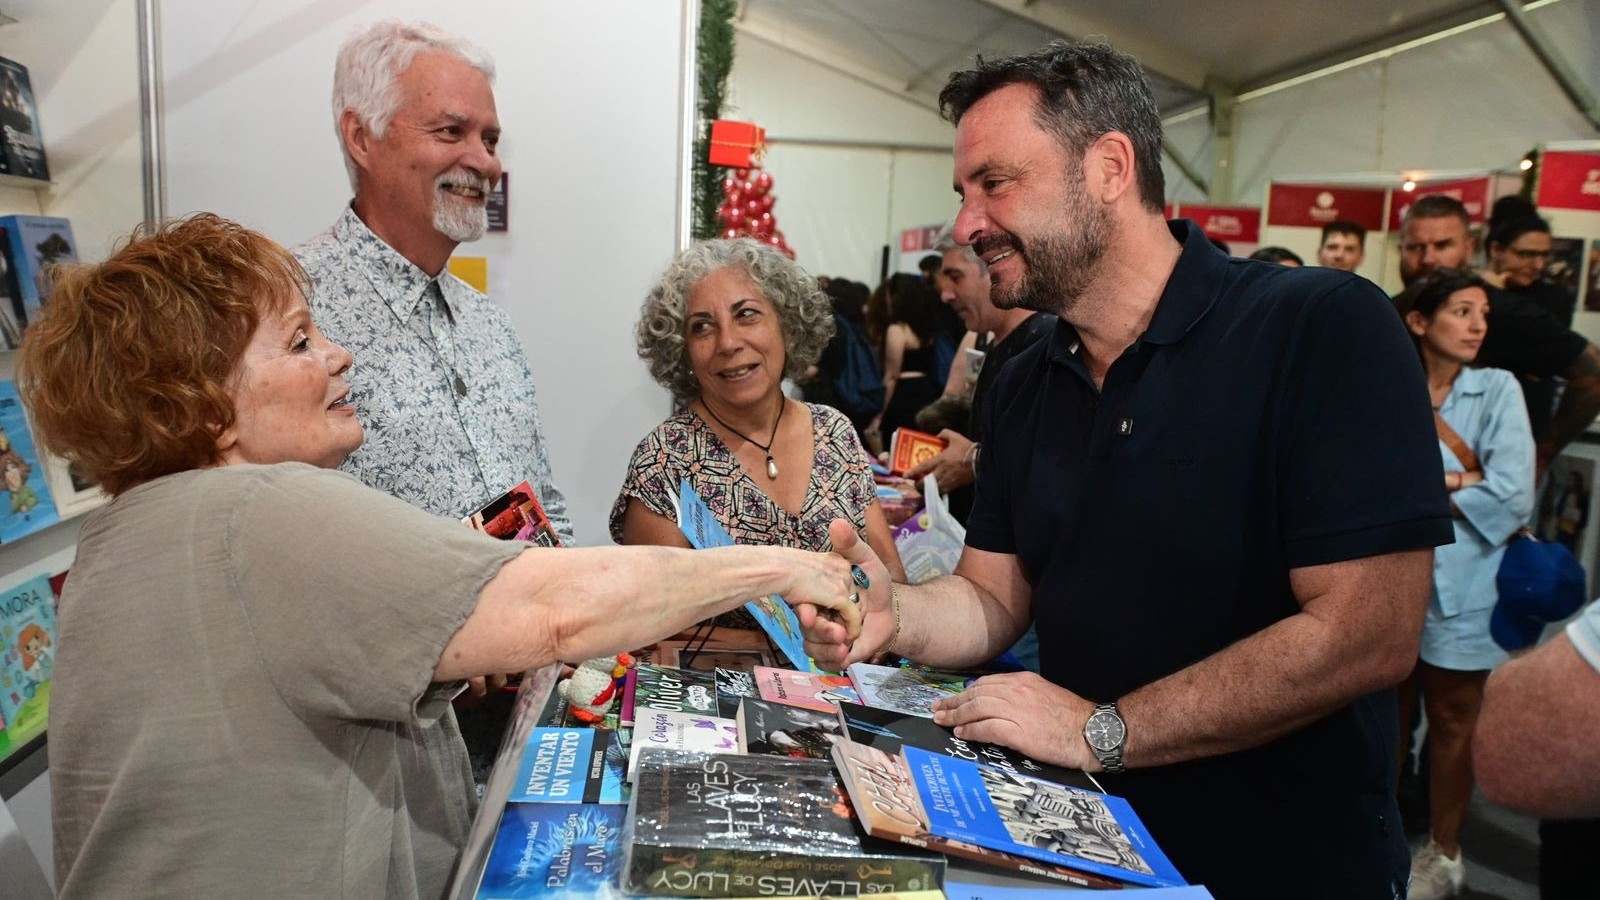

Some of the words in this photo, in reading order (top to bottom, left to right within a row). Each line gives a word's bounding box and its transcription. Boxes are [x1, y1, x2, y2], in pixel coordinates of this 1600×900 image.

[0, 588, 41, 618] MORA
[647, 674, 683, 711] Oliver
[526, 732, 560, 796] INVENTAR
[555, 731, 580, 777] VIENTO
[549, 778, 571, 797] UN
[686, 782, 701, 804] LAS
[703, 761, 734, 838] LLAVES
[732, 770, 763, 826] LUCY
[587, 825, 608, 859] Muro
[546, 831, 576, 889] Palabras
[585, 861, 604, 874] el
[653, 870, 730, 890] LUCY
[734, 874, 754, 886] DE
[758, 877, 861, 897] LLAVES
[867, 882, 895, 894] LAS
